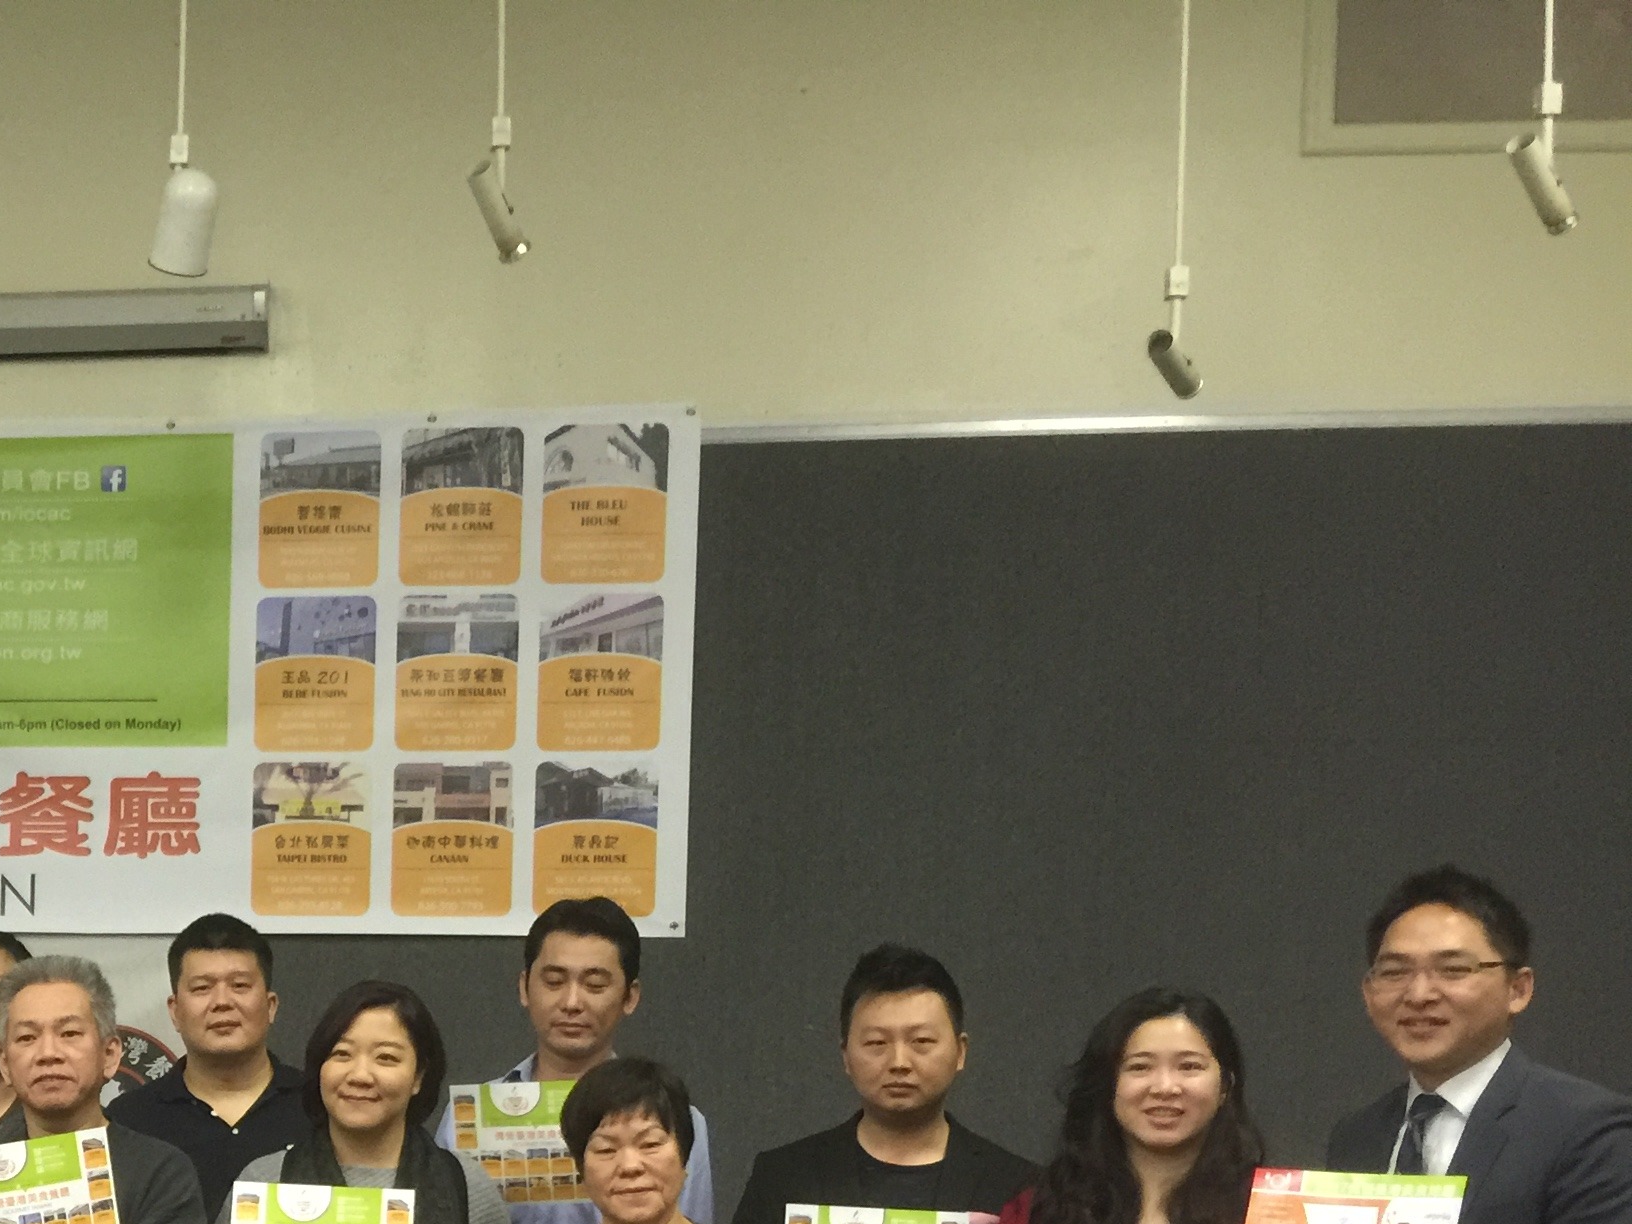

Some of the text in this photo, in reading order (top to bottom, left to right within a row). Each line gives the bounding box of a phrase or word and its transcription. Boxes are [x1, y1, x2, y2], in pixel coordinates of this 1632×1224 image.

[581, 516, 621, 527] HOUSE
[335, 524, 371, 534] CUISINE
[424, 523, 447, 532] PINE
[311, 689, 348, 698] FUSION
[565, 688, 634, 697] CAFE FUSION
[51, 718, 100, 733] (Closed
[104, 721, 121, 731] on
[125, 718, 181, 733] Monday)
[277, 854, 347, 863] TAIPEI BISTRO
[561, 854, 628, 863] DUCK HOUSE
